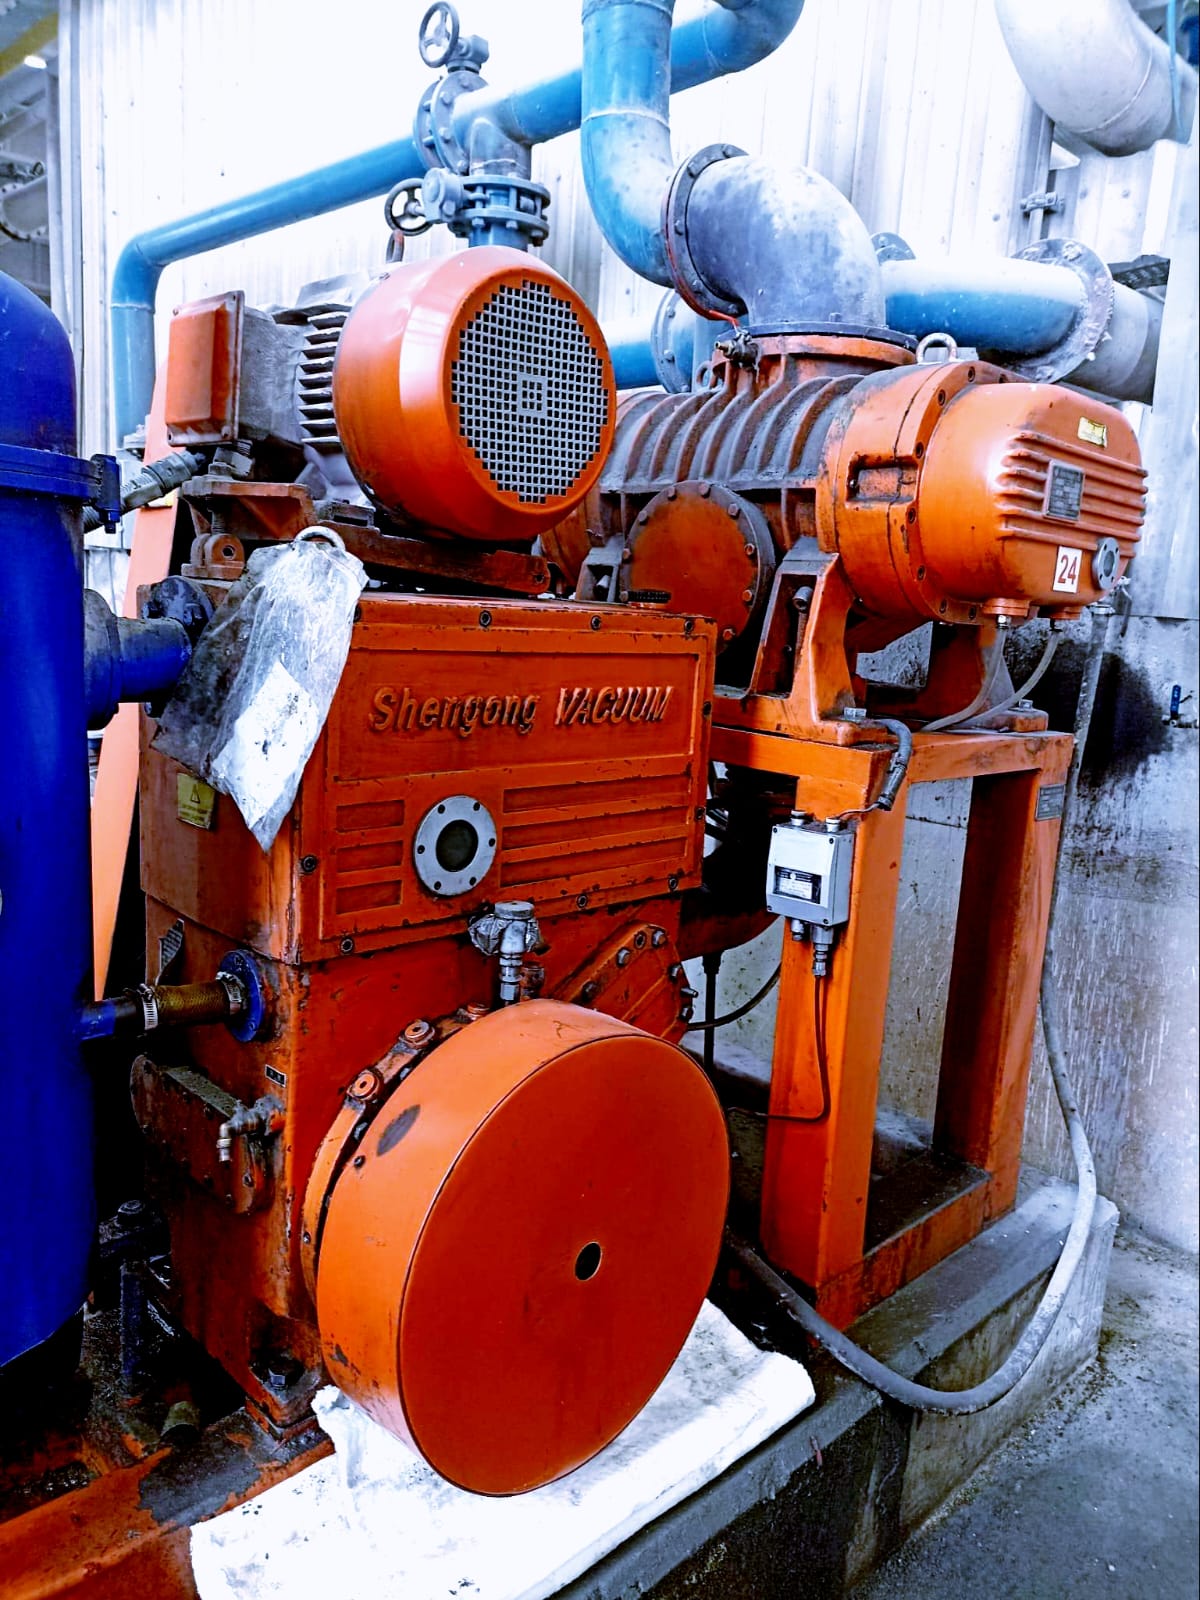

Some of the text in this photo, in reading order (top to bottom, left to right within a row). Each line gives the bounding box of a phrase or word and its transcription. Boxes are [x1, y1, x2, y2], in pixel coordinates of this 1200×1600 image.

[1057, 554, 1078, 585] 24
[368, 685, 674, 737] Shengong VACUUM
